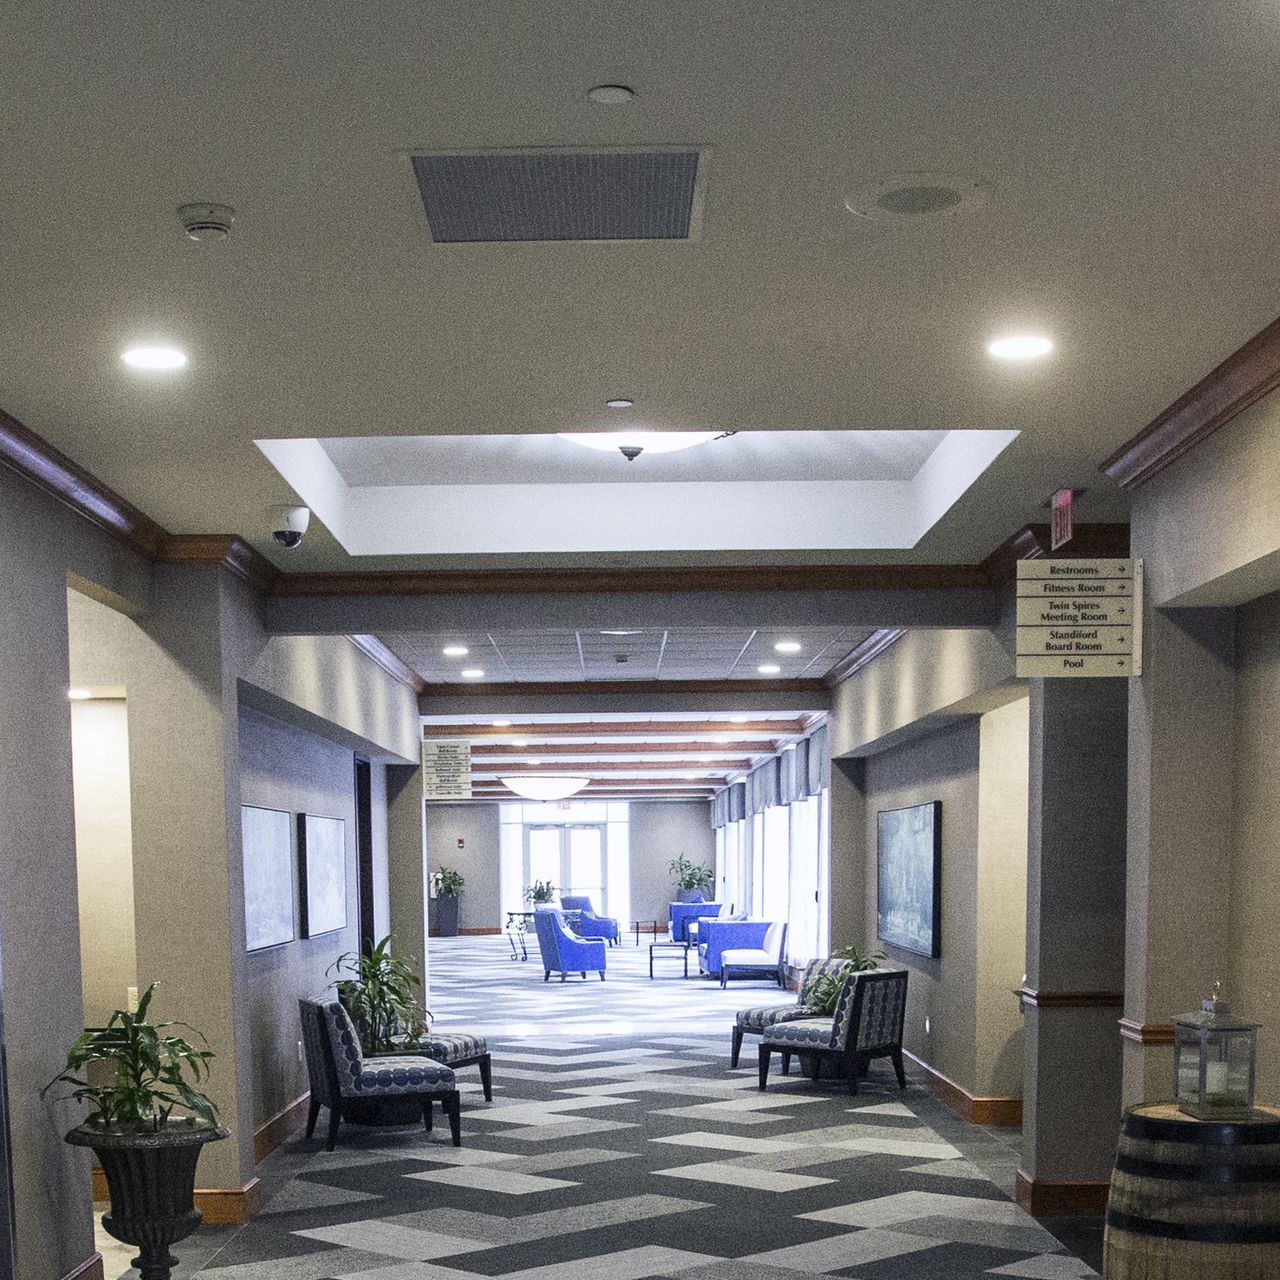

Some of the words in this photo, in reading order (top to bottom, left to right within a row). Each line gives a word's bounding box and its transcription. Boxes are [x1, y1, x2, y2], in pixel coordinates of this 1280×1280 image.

[1050, 566, 1099, 575] Restrooms
[1043, 583, 1075, 593] Fitness
[1078, 583, 1105, 592] Room
[1048, 601, 1070, 610] Twin
[1072, 601, 1100, 612] Spires
[1040, 613, 1079, 623] Meeting
[1081, 613, 1108, 621] Room
[1050, 630, 1098, 639] Standiford
[1045, 642, 1073, 651] Board
[1075, 642, 1102, 651] Room
[1063, 659, 1084, 668] Pool
